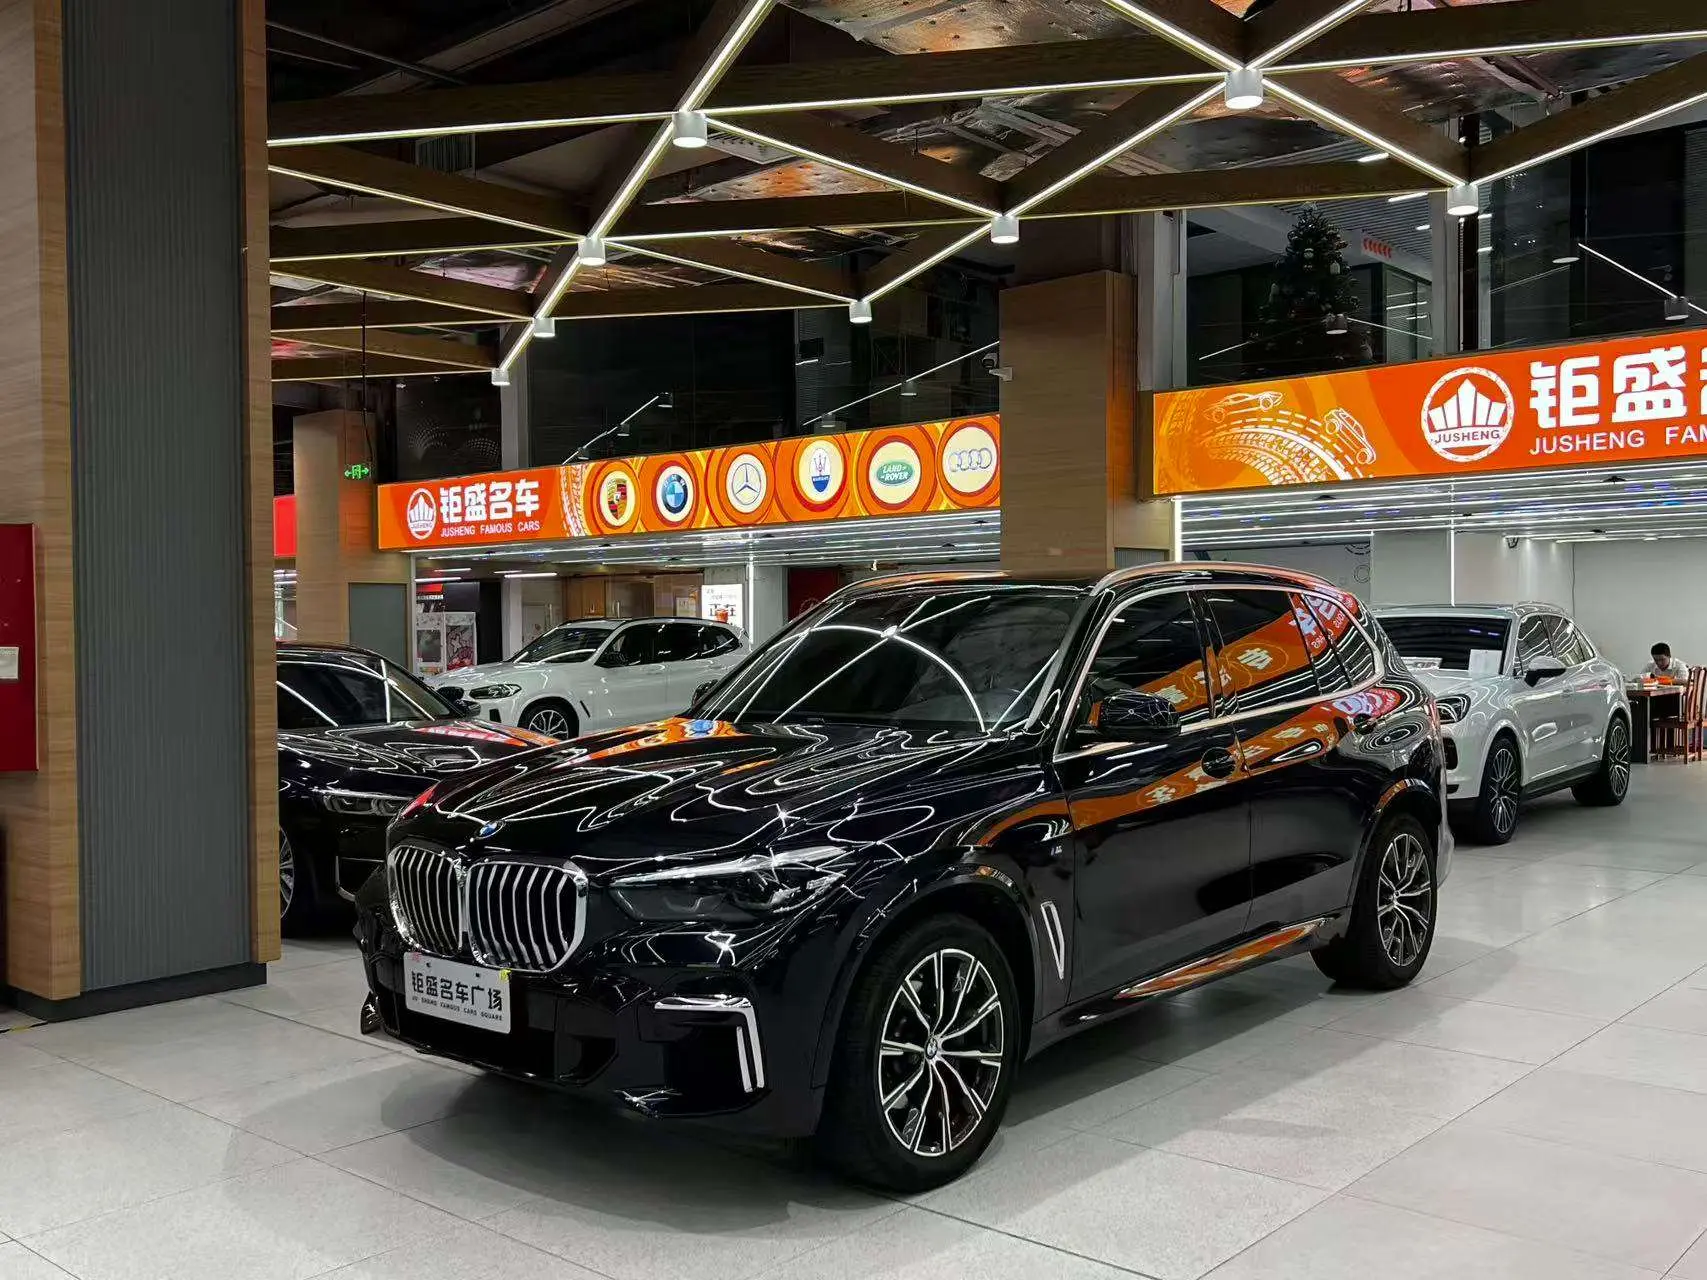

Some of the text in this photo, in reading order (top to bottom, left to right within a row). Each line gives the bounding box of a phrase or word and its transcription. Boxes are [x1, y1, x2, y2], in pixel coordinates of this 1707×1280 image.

[1530, 345, 1707, 429] 钜盛
[1434, 429, 1500, 445] JUSHENG
[1530, 430, 1645, 456] JUSHENG
[440, 479, 539, 523] 钜盛名车
[441, 521, 540, 537] JUSHENG FAMOUS CARS
[412, 970, 502, 1011] 钜盛名车广场
[463, 1006, 477, 1016] CARS
